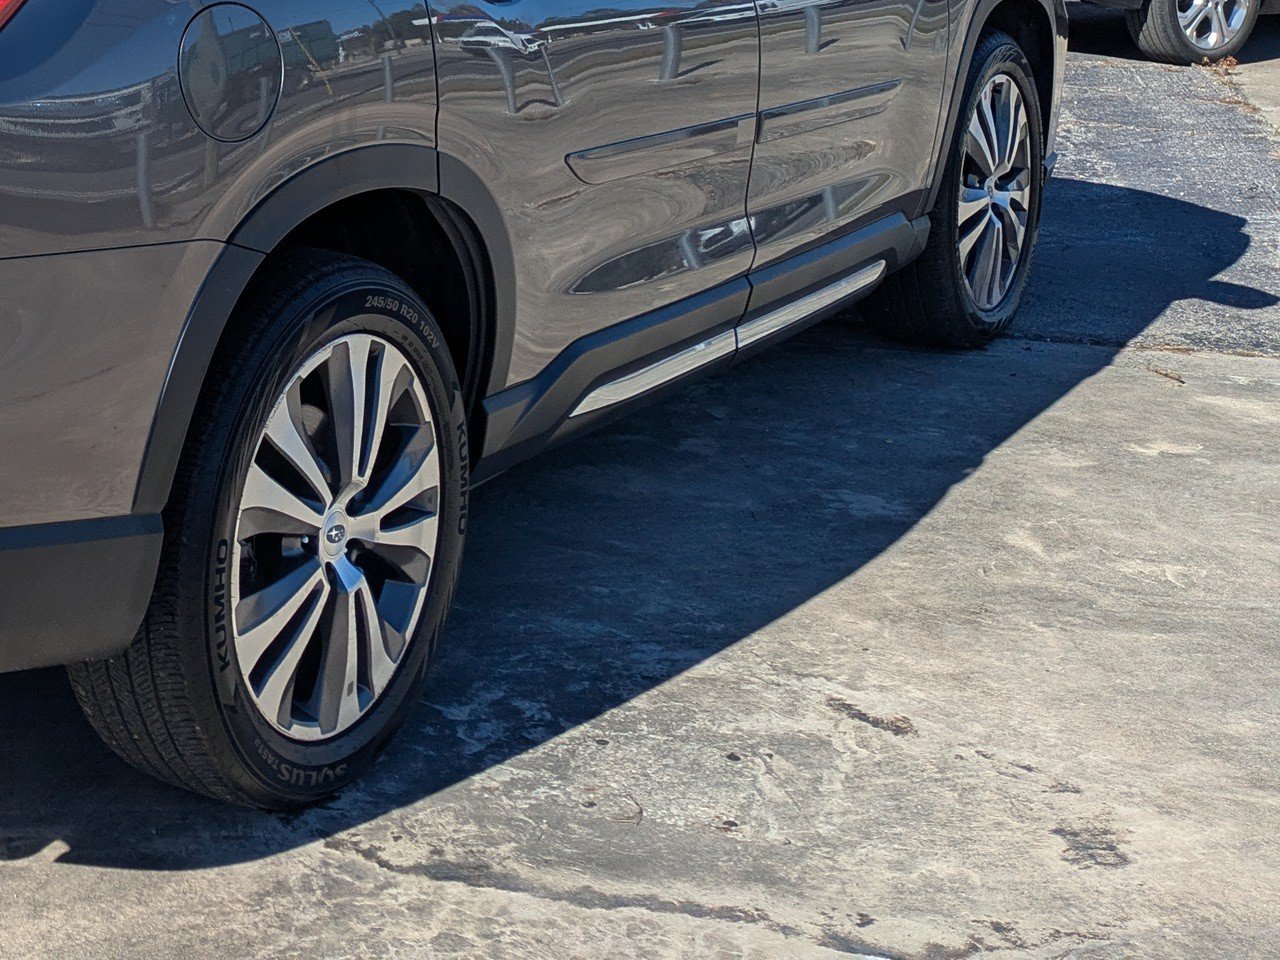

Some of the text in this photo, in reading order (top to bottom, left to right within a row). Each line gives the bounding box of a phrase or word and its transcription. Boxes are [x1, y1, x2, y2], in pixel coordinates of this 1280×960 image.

[365, 295, 399, 312] 245/50
[400, 303, 419, 324] R20
[456, 420, 468, 536] KUMHO
[213, 538, 230, 673] KUMHO
